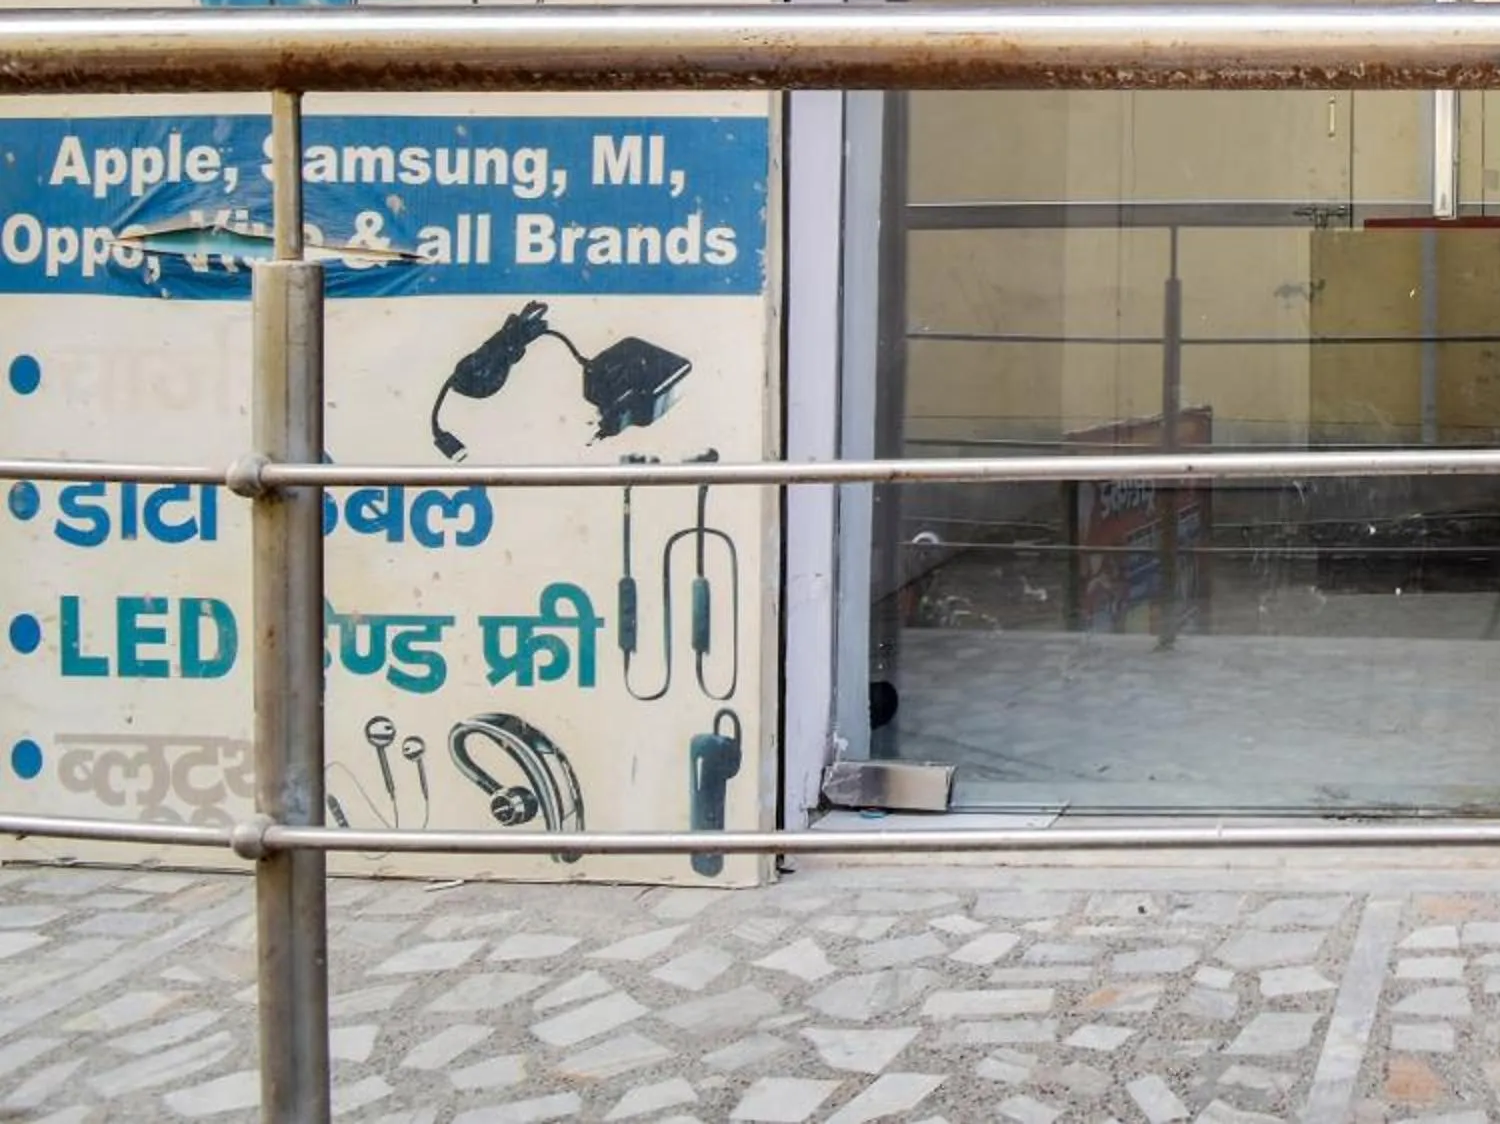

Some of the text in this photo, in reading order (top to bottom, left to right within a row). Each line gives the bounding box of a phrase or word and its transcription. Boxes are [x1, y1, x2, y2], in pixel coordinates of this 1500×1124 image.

[49, 132, 238, 198] Apple,
[592, 134, 686, 196] MI,
[416, 214, 489, 265] all
[515, 214, 738, 267] Brands
[60, 595, 239, 678] LED
[478, 581, 604, 689] फ्री
